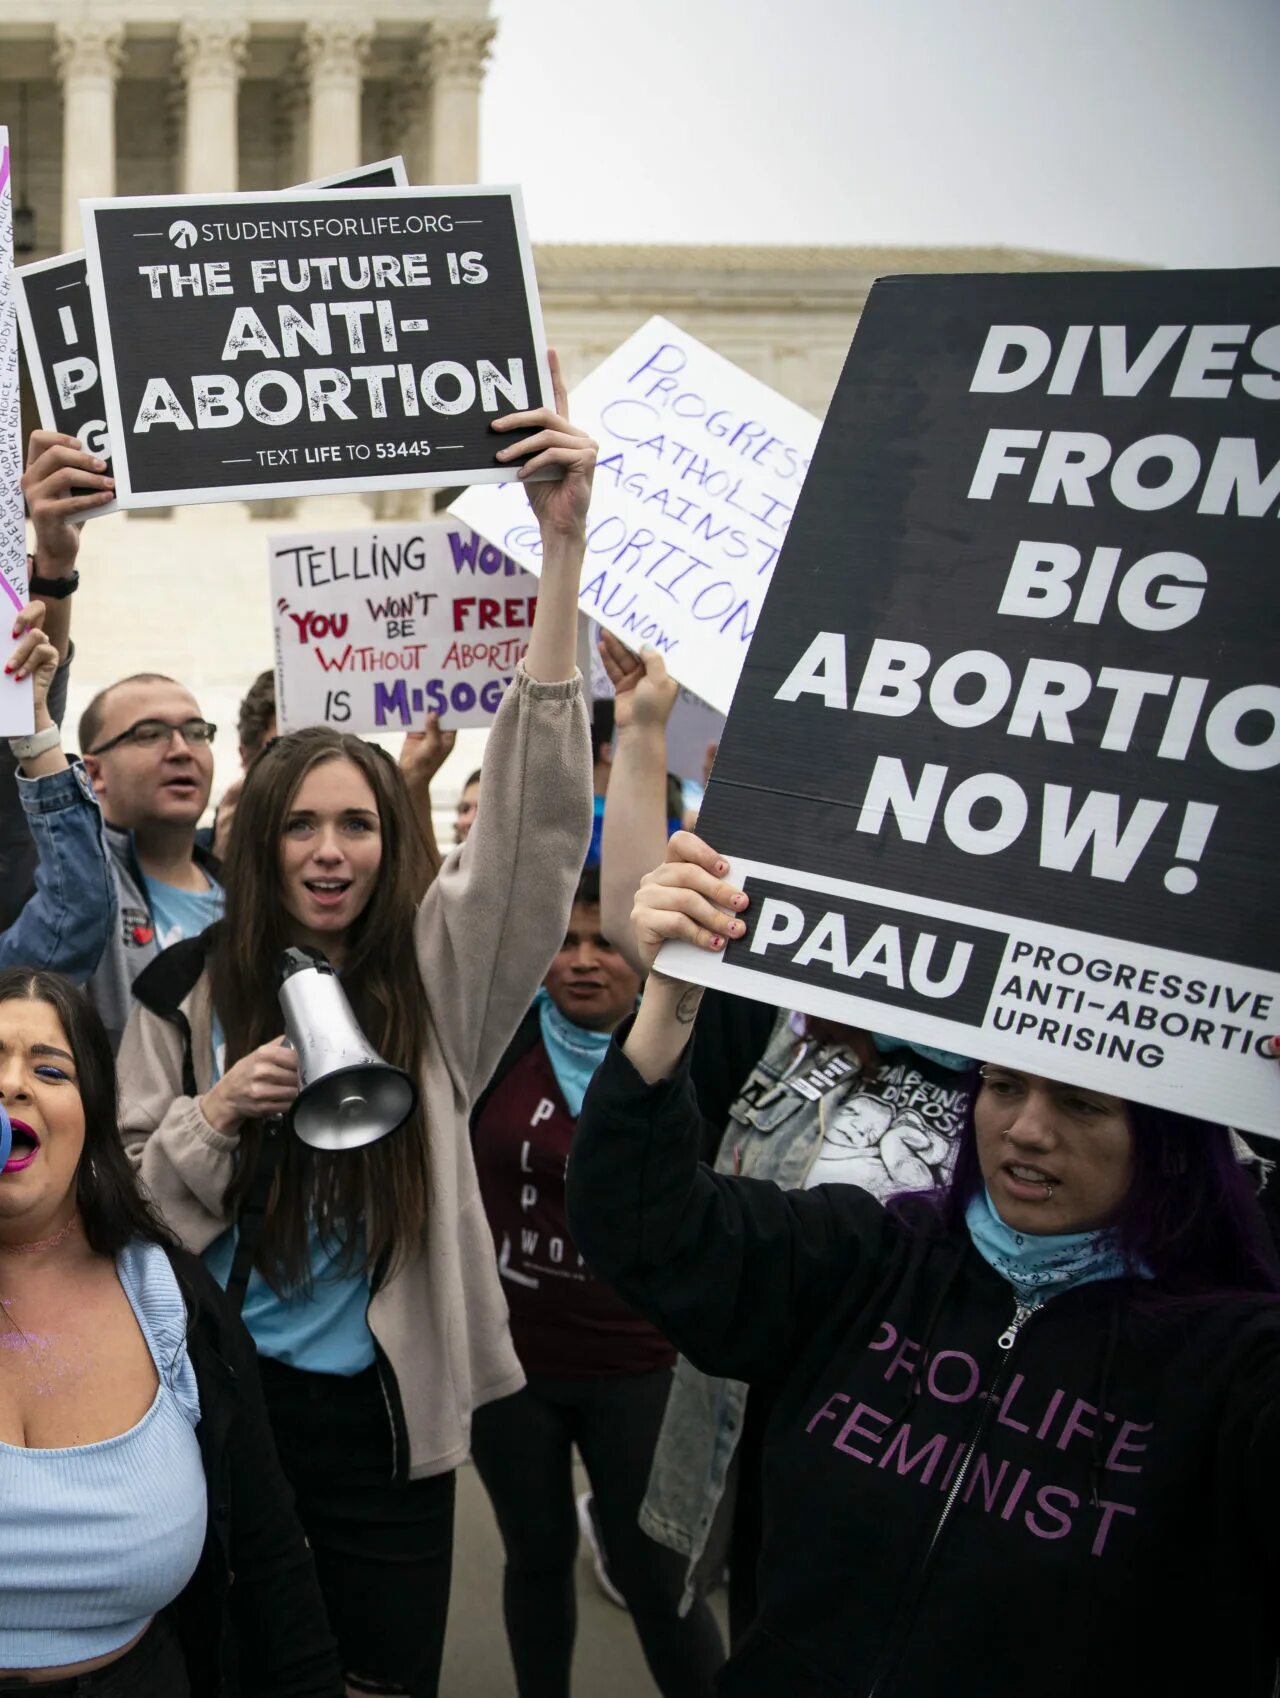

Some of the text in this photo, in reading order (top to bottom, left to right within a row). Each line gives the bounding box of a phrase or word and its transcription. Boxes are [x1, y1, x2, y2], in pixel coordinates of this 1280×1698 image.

[202, 215, 453, 243] STUDENTSFORLIFE.ORG
[138, 251, 489, 299] THE FUTURE IS
[221, 300, 428, 361] ANTI-
[133, 358, 529, 434] ABORTION
[256, 440, 431, 467] TEXT LIFE TO 53445
[600, 400, 794, 534] CATHOLI
[967, 429, 1280, 518] FROM
[596, 454, 780, 576] AGAINST
[386, 620, 415, 639] BE
[997, 540, 1208, 631] BIG
[324, 690, 351, 721] IS
[774, 631, 1280, 770] ABORTIO
[856, 755, 1219, 894] NOW!
[749, 897, 1274, 1020] PAAU PROGRESSIVE
[992, 1007, 1165, 1069] UPRISING
[868, 1321, 1156, 1476] PRO-LIFE
[805, 1391, 1137, 1559] FEMINIST
